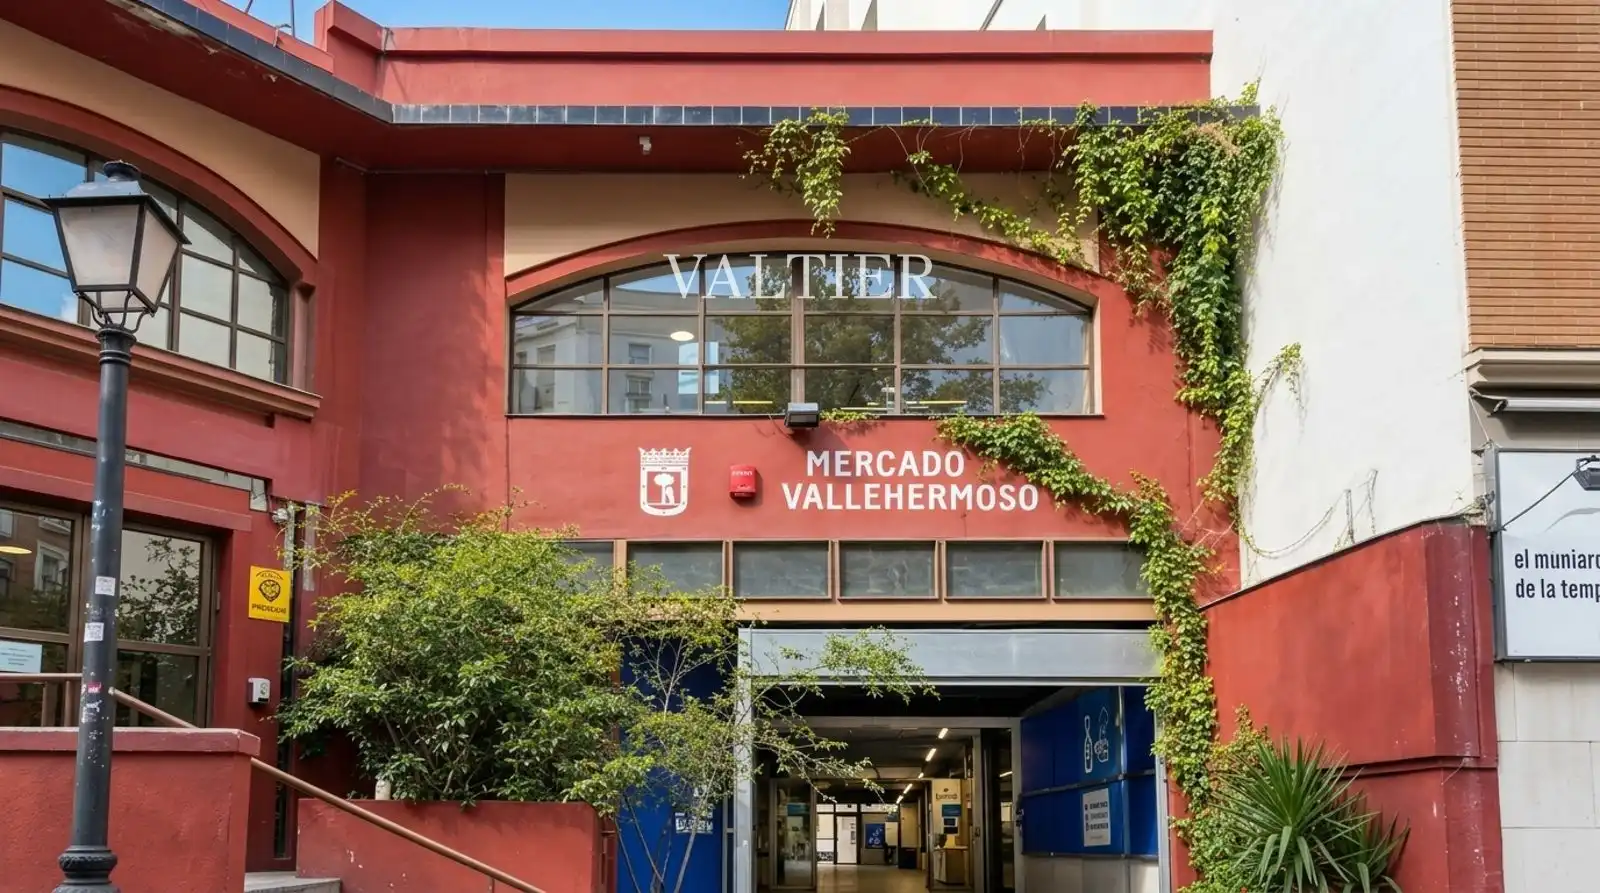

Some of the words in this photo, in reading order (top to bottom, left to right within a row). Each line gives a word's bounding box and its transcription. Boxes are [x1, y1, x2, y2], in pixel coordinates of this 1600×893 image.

[806, 450, 965, 477] MERCADO
[781, 482, 1039, 511] VALLEHERMOSO
[1514, 548, 1529, 569] el
[1515, 578, 1536, 599] de
[1540, 578, 1556, 599] la
